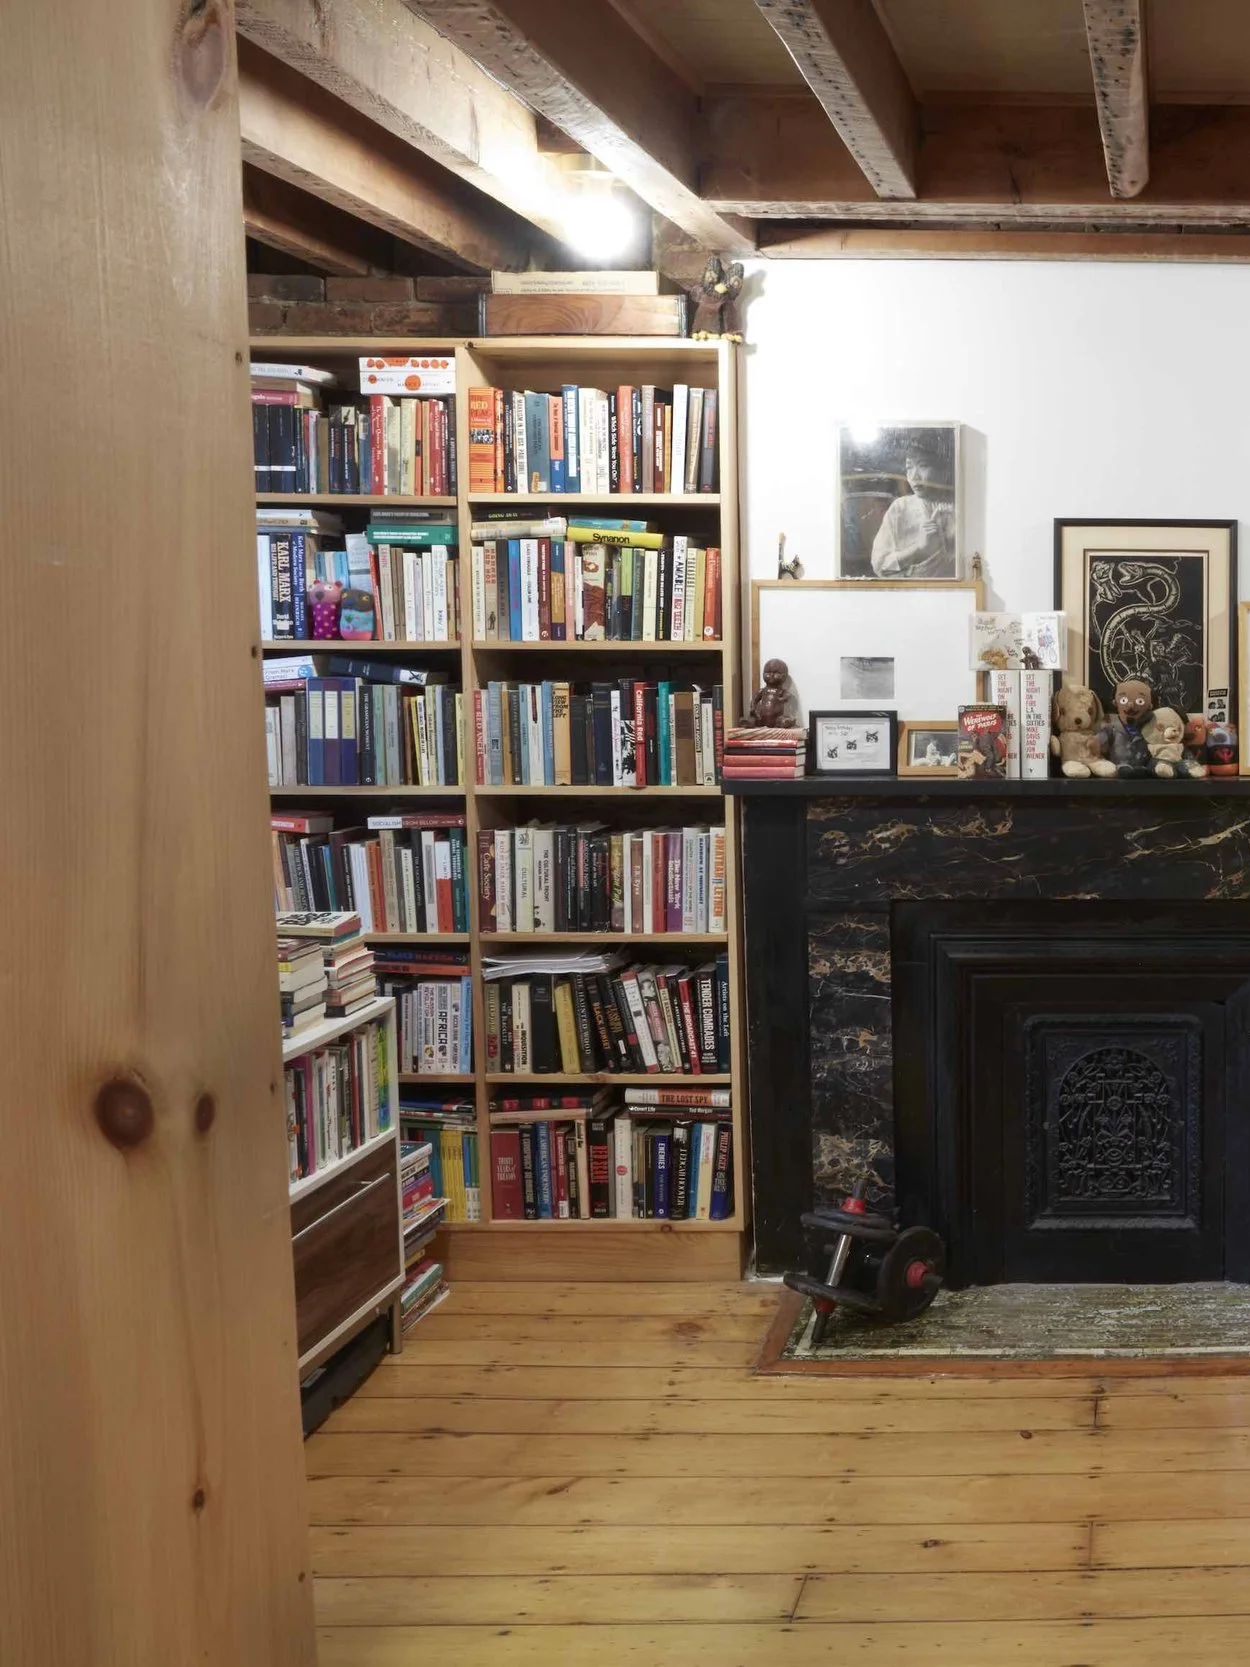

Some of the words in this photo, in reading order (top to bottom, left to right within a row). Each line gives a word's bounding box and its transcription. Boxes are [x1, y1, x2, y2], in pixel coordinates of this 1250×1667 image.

[592, 533, 630, 544] Synanon
[278, 542, 291, 570] KARL
[278, 572, 291, 602] MARX
[674, 561, 683, 592] AMIABLE
[978, 720, 997, 729] PARIS
[715, 834, 724, 878] JONATHAN
[483, 873, 492, 900] Society
[714, 886, 723, 916] LETHEM
[701, 978, 712, 1007] TENDER
[578, 992, 587, 1029] HAUNTED
[438, 1011, 447, 1044] AFRICA
[685, 1015, 695, 1049] BROADCAST
[703, 1008, 714, 1050] COMRADES
[695, 1096, 707, 1104] SPY
[720, 1132, 728, 1154] PHILIP
